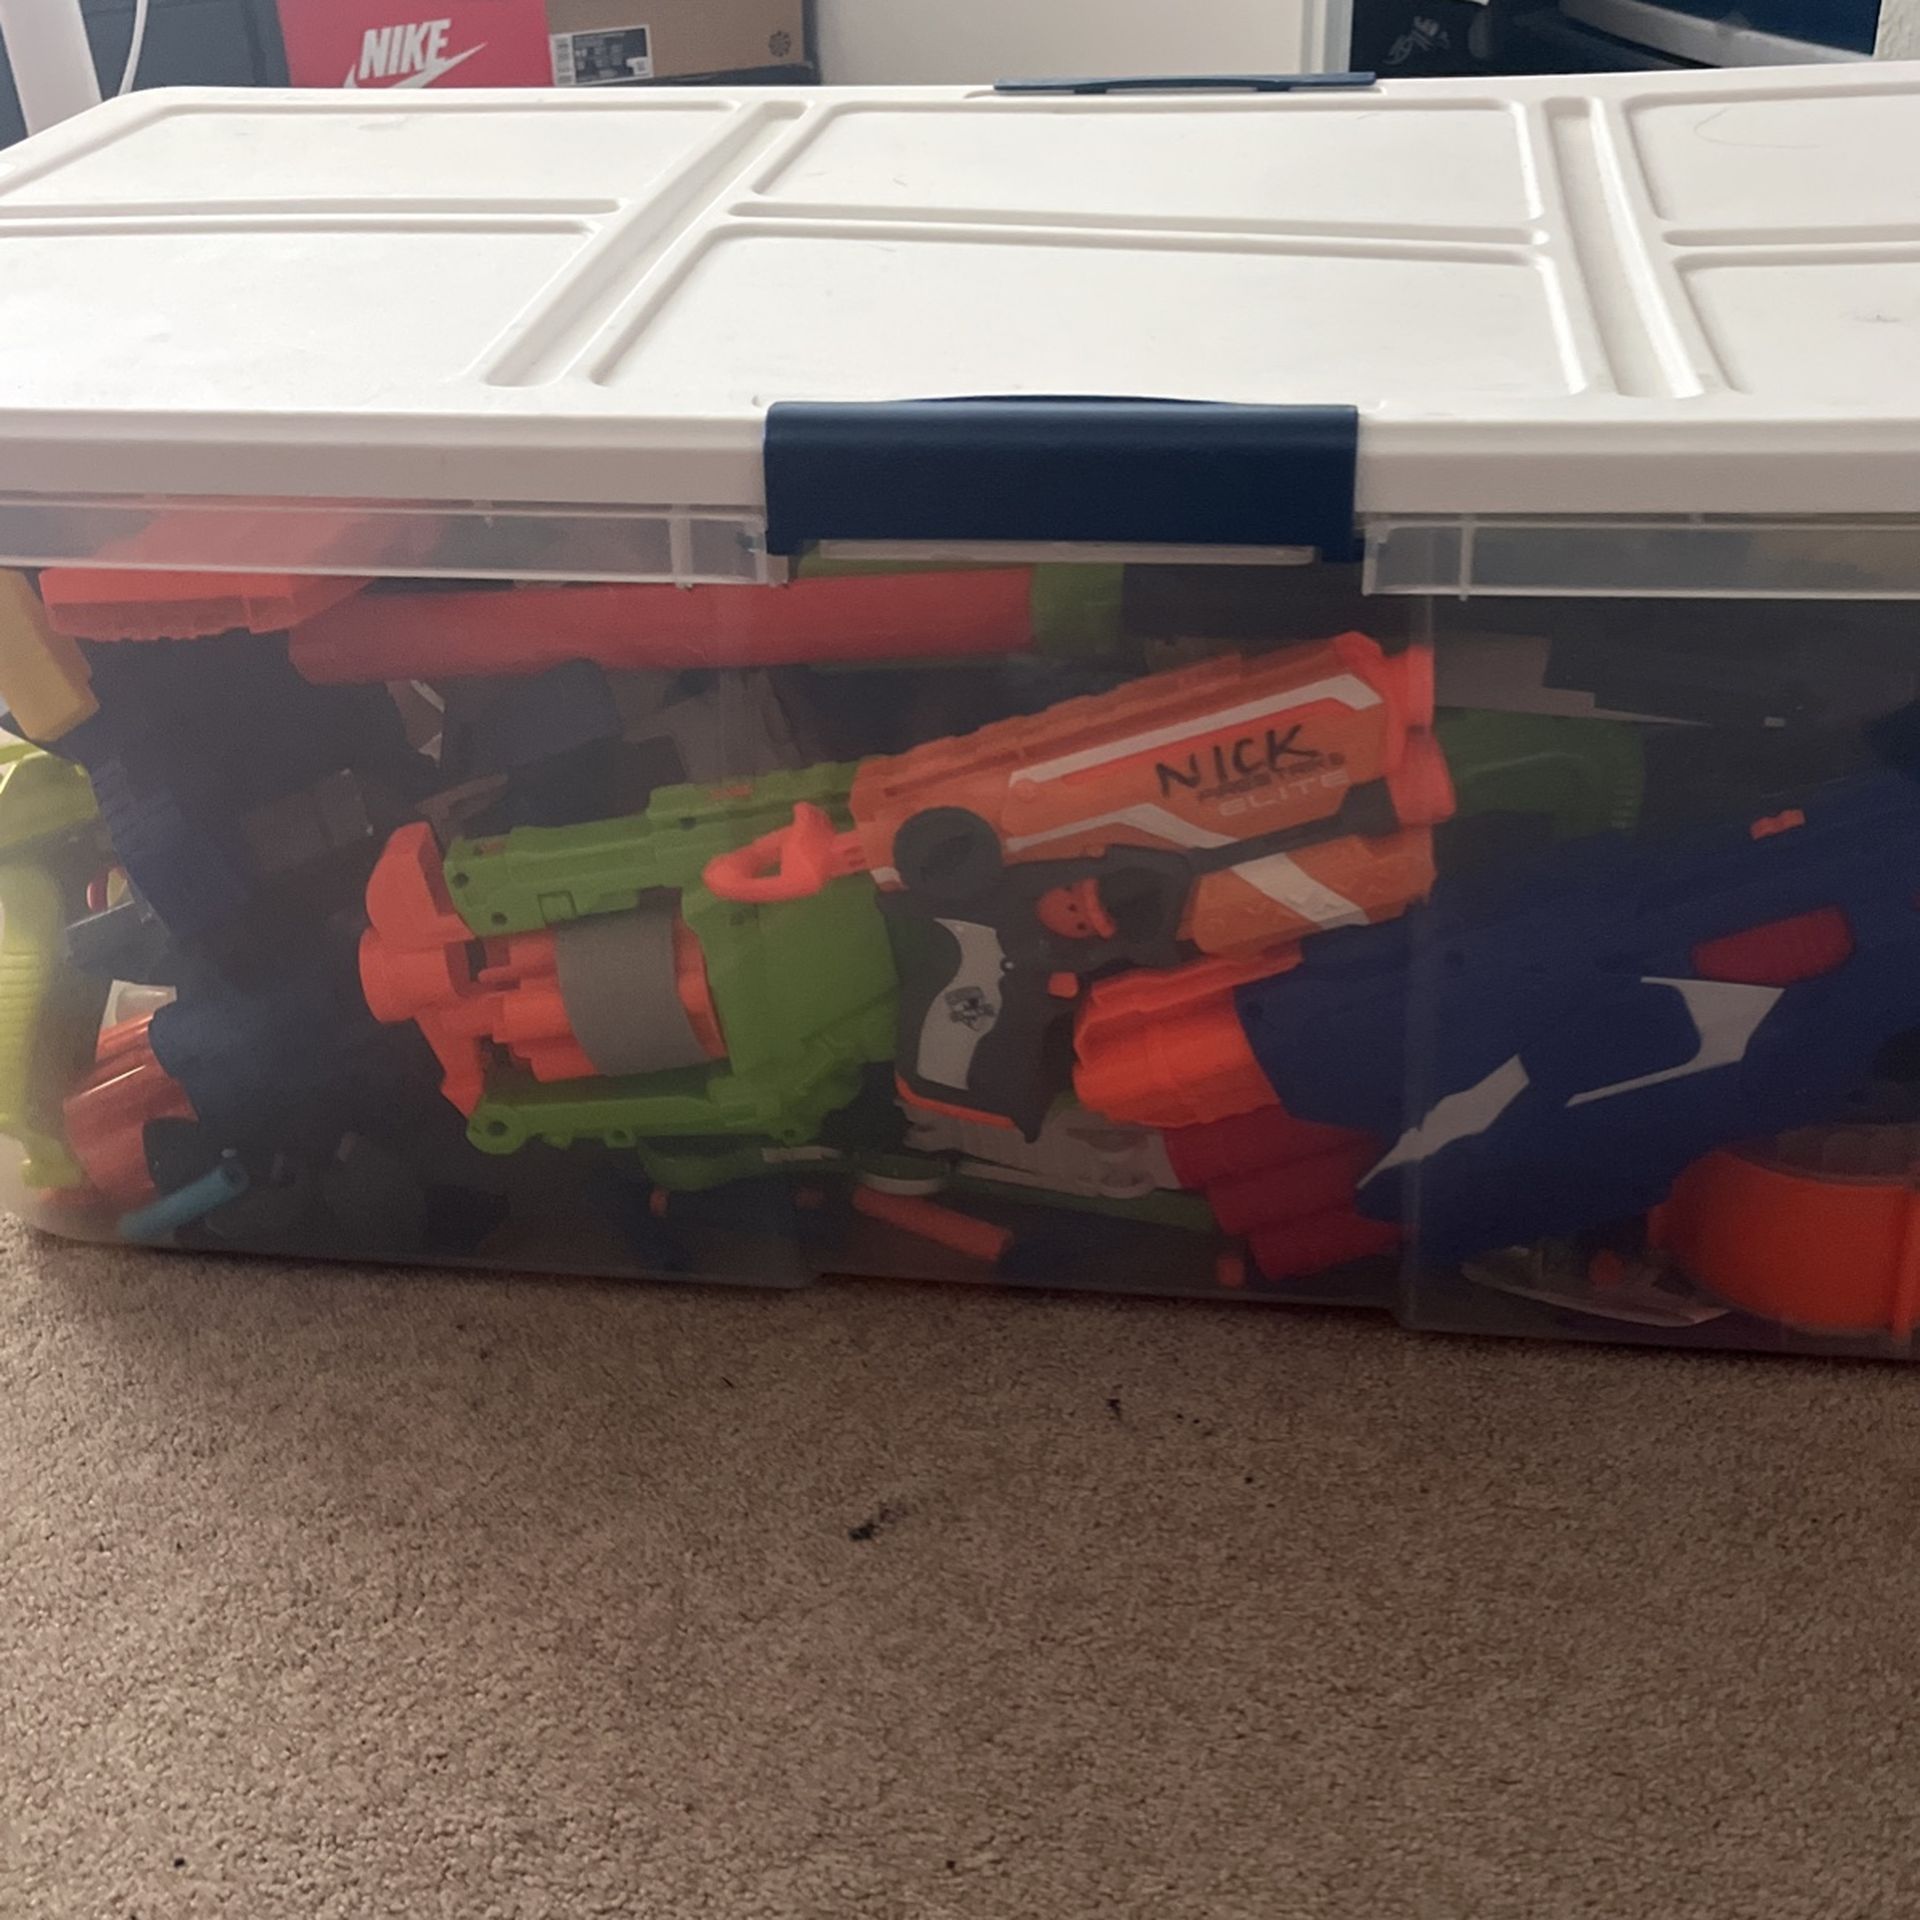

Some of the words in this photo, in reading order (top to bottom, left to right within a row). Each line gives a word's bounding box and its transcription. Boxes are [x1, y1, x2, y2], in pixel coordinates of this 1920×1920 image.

[358, 18, 451, 80] NIKE
[1155, 723, 1319, 799] NICK
[1218, 769, 1350, 817] ELITE
